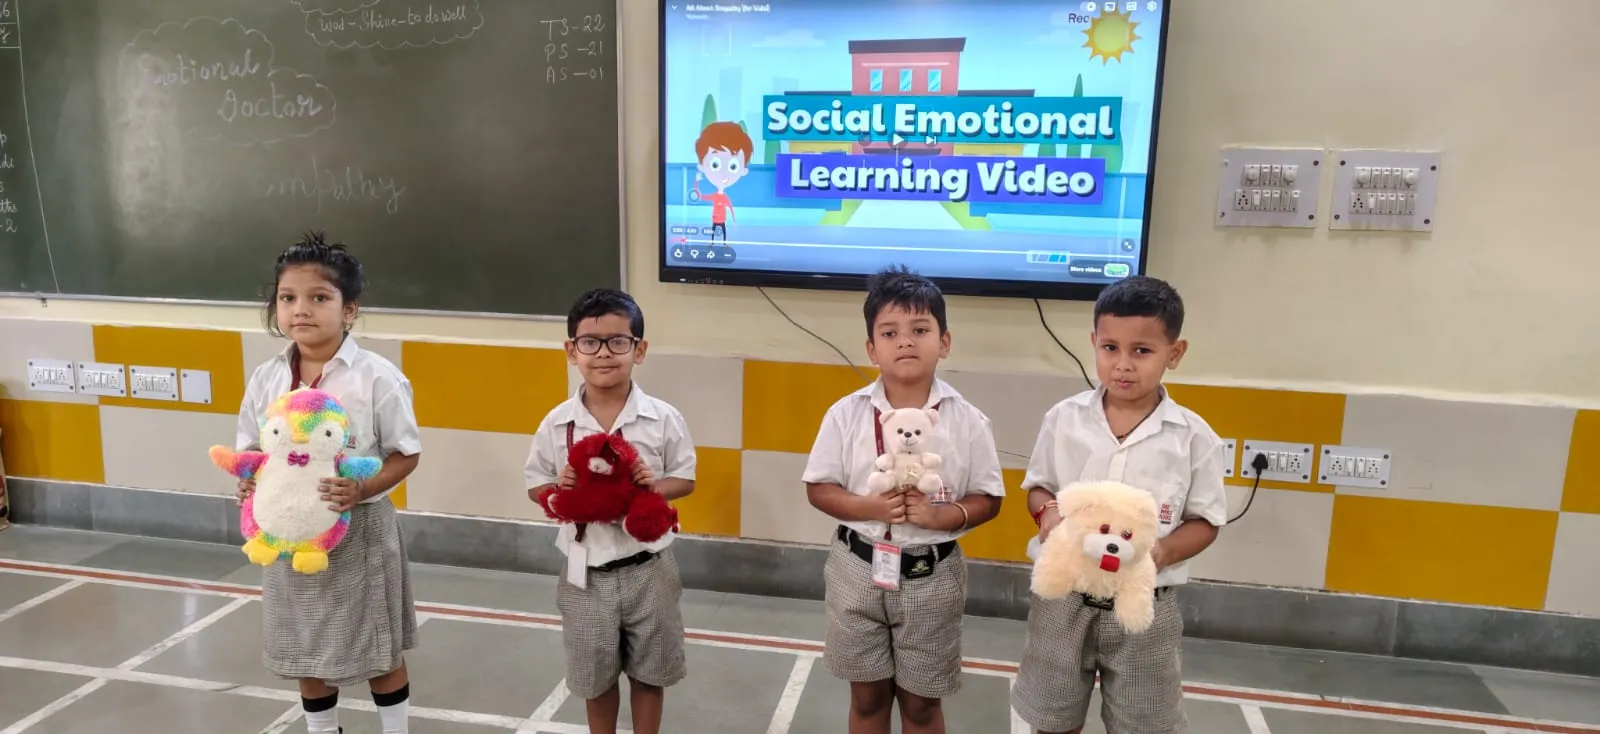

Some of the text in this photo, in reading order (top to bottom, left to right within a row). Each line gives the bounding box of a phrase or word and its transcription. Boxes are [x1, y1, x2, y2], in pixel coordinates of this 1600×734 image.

[767, 98, 1114, 139] Social Emotional
[790, 157, 1097, 202] Learning Video
